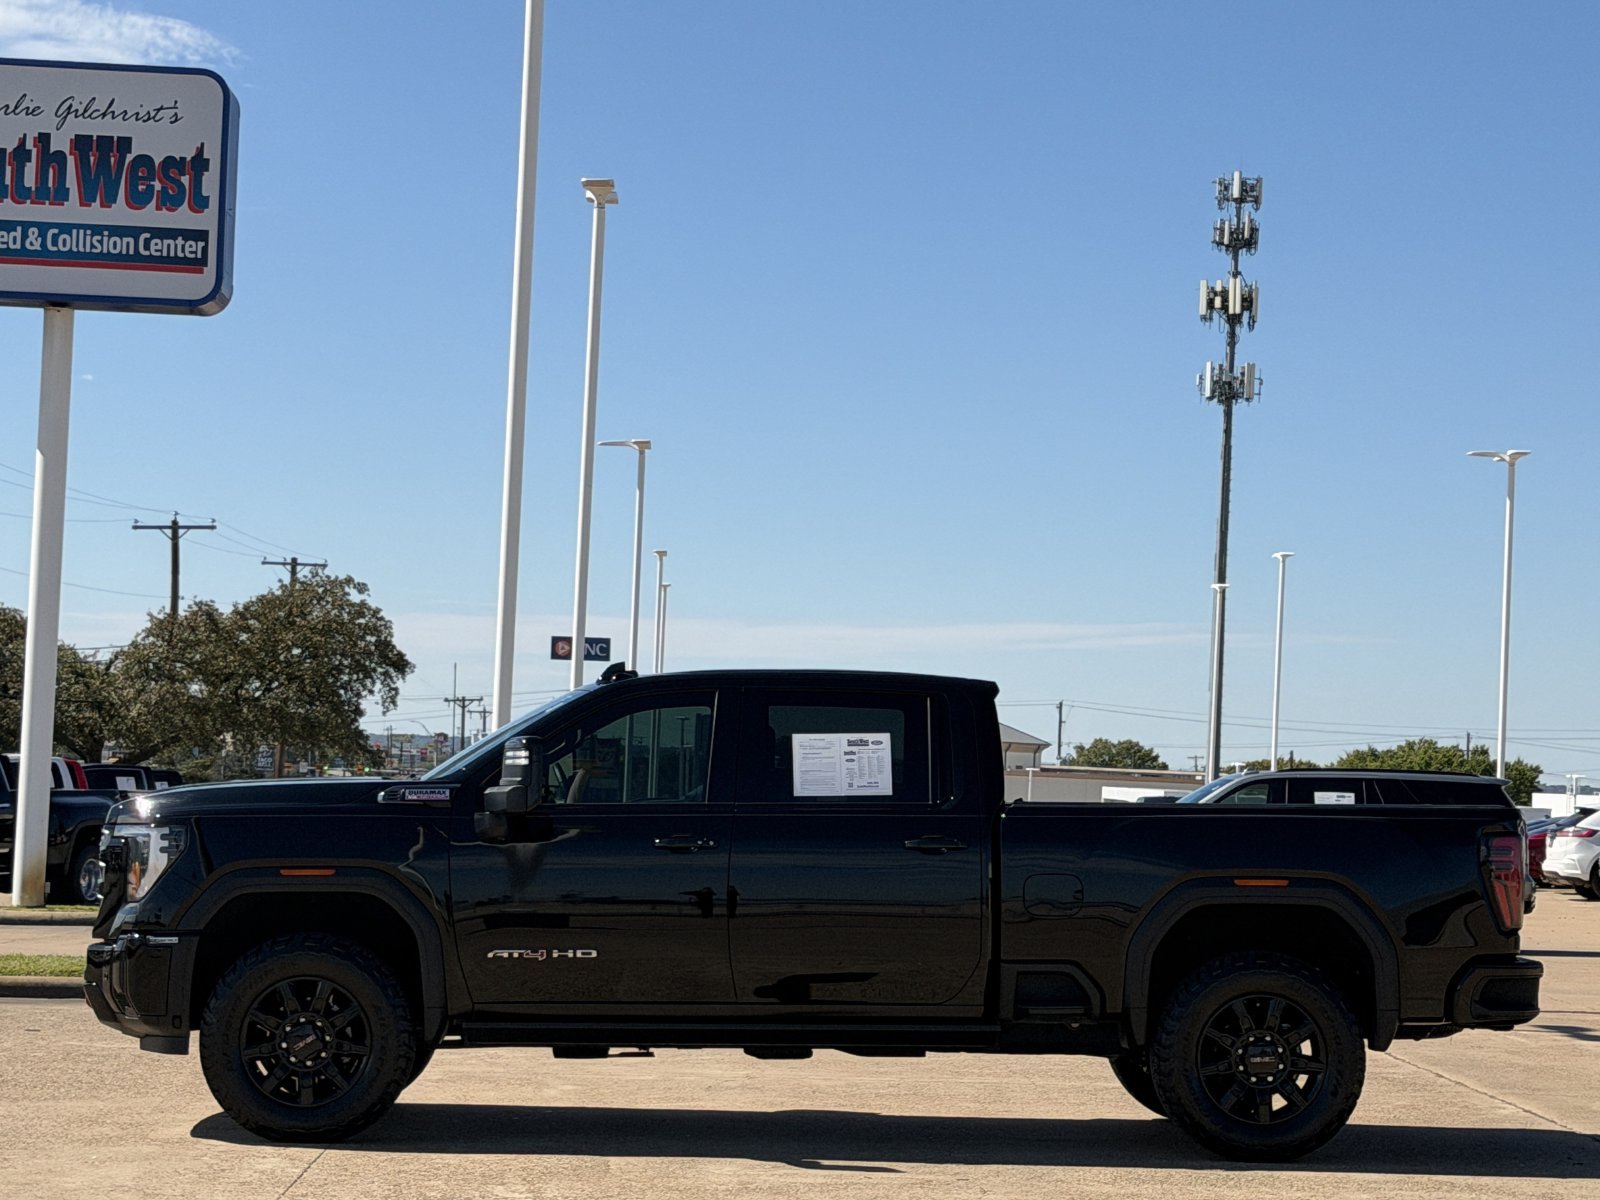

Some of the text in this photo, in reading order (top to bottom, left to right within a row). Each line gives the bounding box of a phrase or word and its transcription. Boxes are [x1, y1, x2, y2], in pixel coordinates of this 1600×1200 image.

[54, 96, 184, 131] Gilchrist's
[25, 227, 42, 250] &
[46, 229, 135, 255] Collision
[138, 232, 206, 258] Center
[584, 643, 607, 656] NC
[487, 949, 598, 961] AT4 HD
